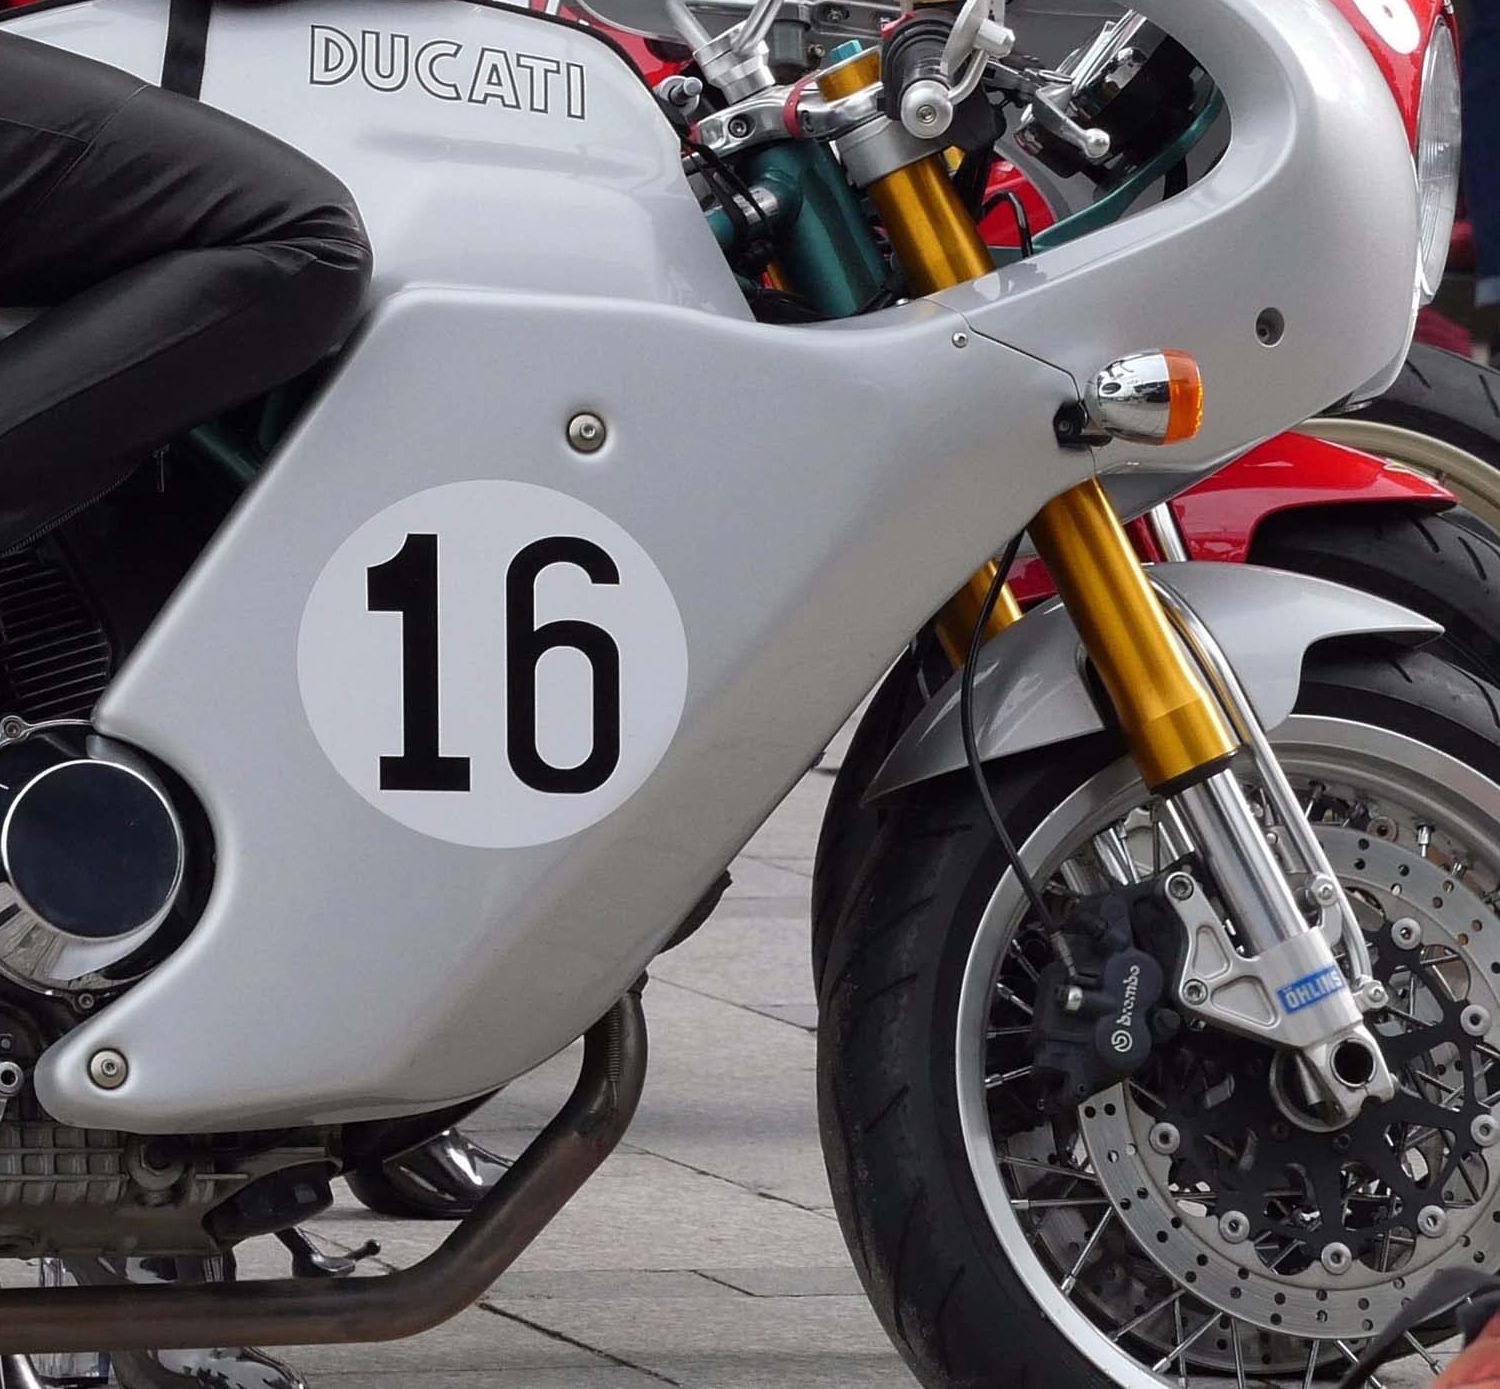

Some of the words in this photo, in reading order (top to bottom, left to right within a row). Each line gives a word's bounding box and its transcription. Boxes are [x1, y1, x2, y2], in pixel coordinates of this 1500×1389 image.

[310, 24, 586, 120] DUCATI
[366, 533, 620, 794] 16
[1116, 965, 1140, 1026] brembo
